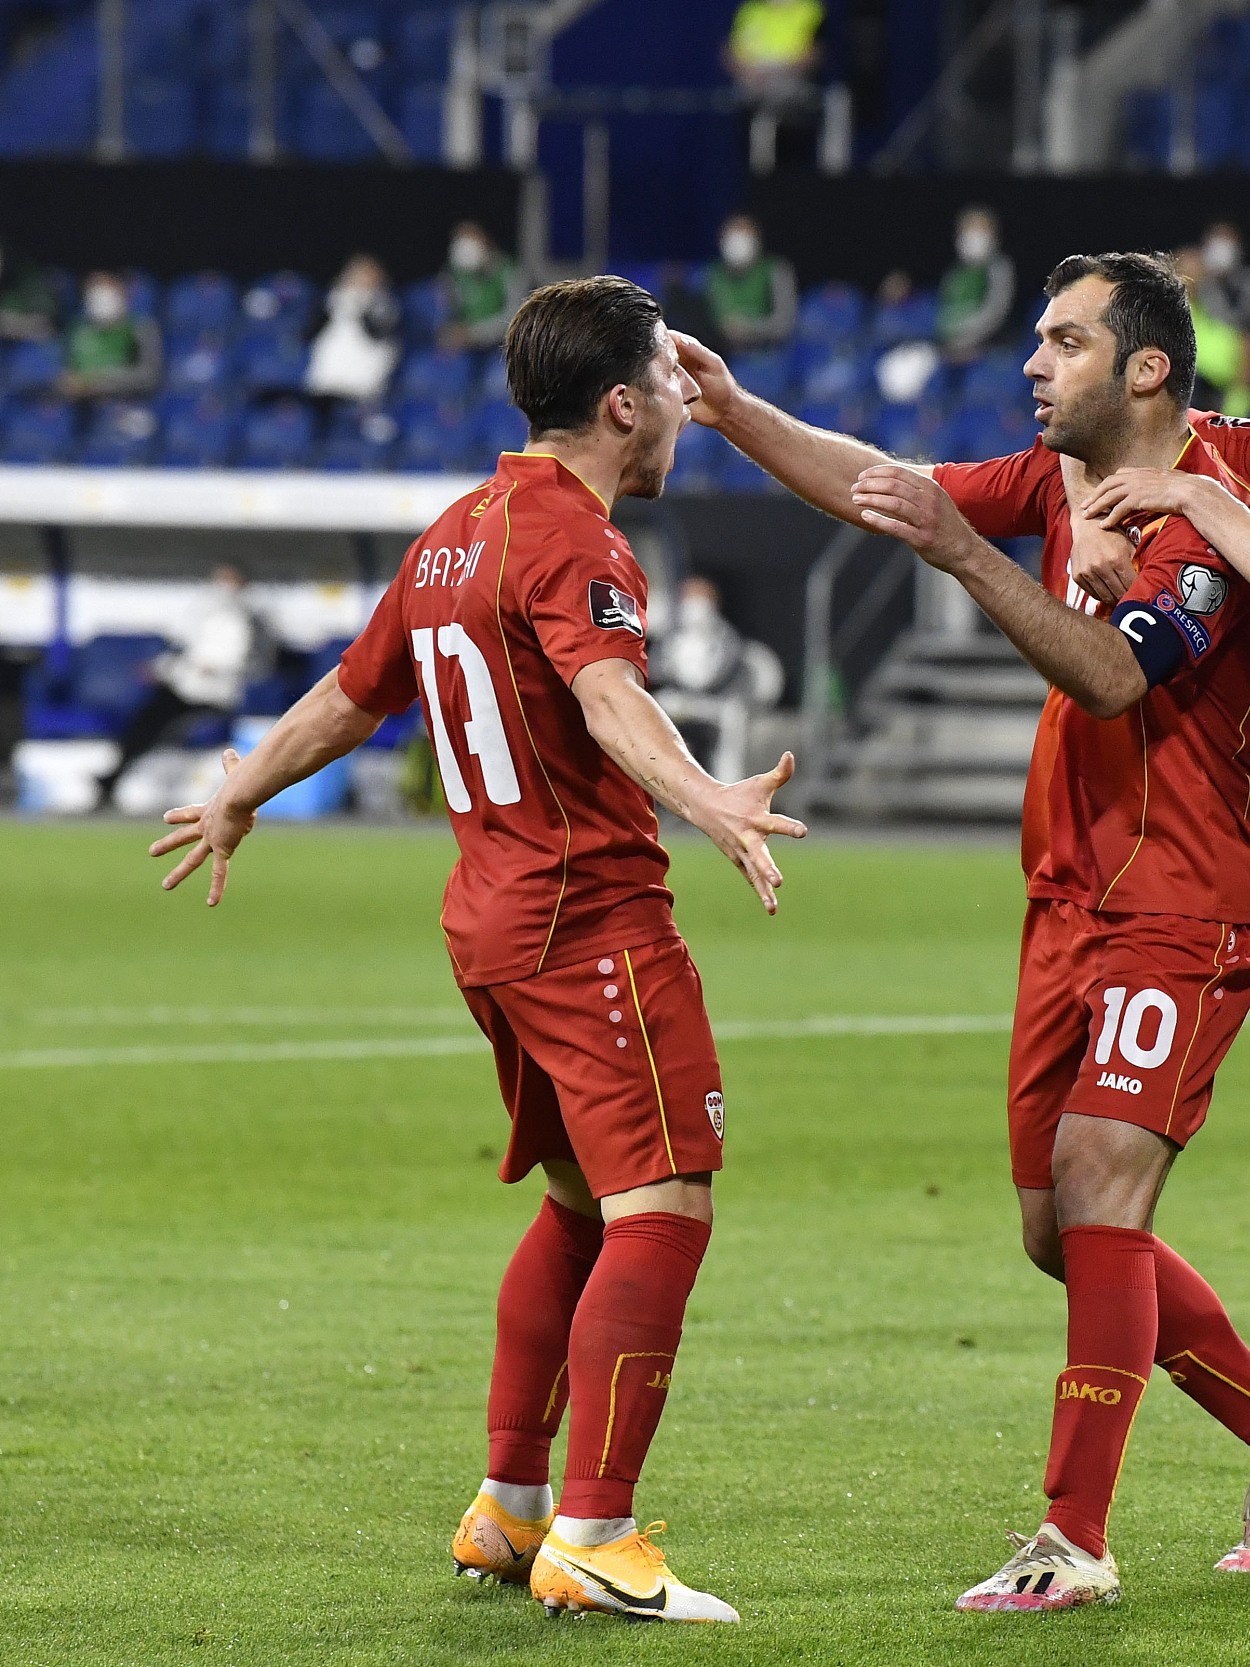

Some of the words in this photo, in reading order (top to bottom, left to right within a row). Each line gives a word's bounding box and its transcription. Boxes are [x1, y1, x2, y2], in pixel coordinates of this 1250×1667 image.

[1118, 609, 1157, 644] C
[1173, 607, 1207, 653] RESPECT
[411, 622, 522, 814] 17
[1094, 986, 1178, 1069] 10
[1096, 1071, 1143, 1095] JAKO
[1059, 1380, 1122, 1406] JAKO
